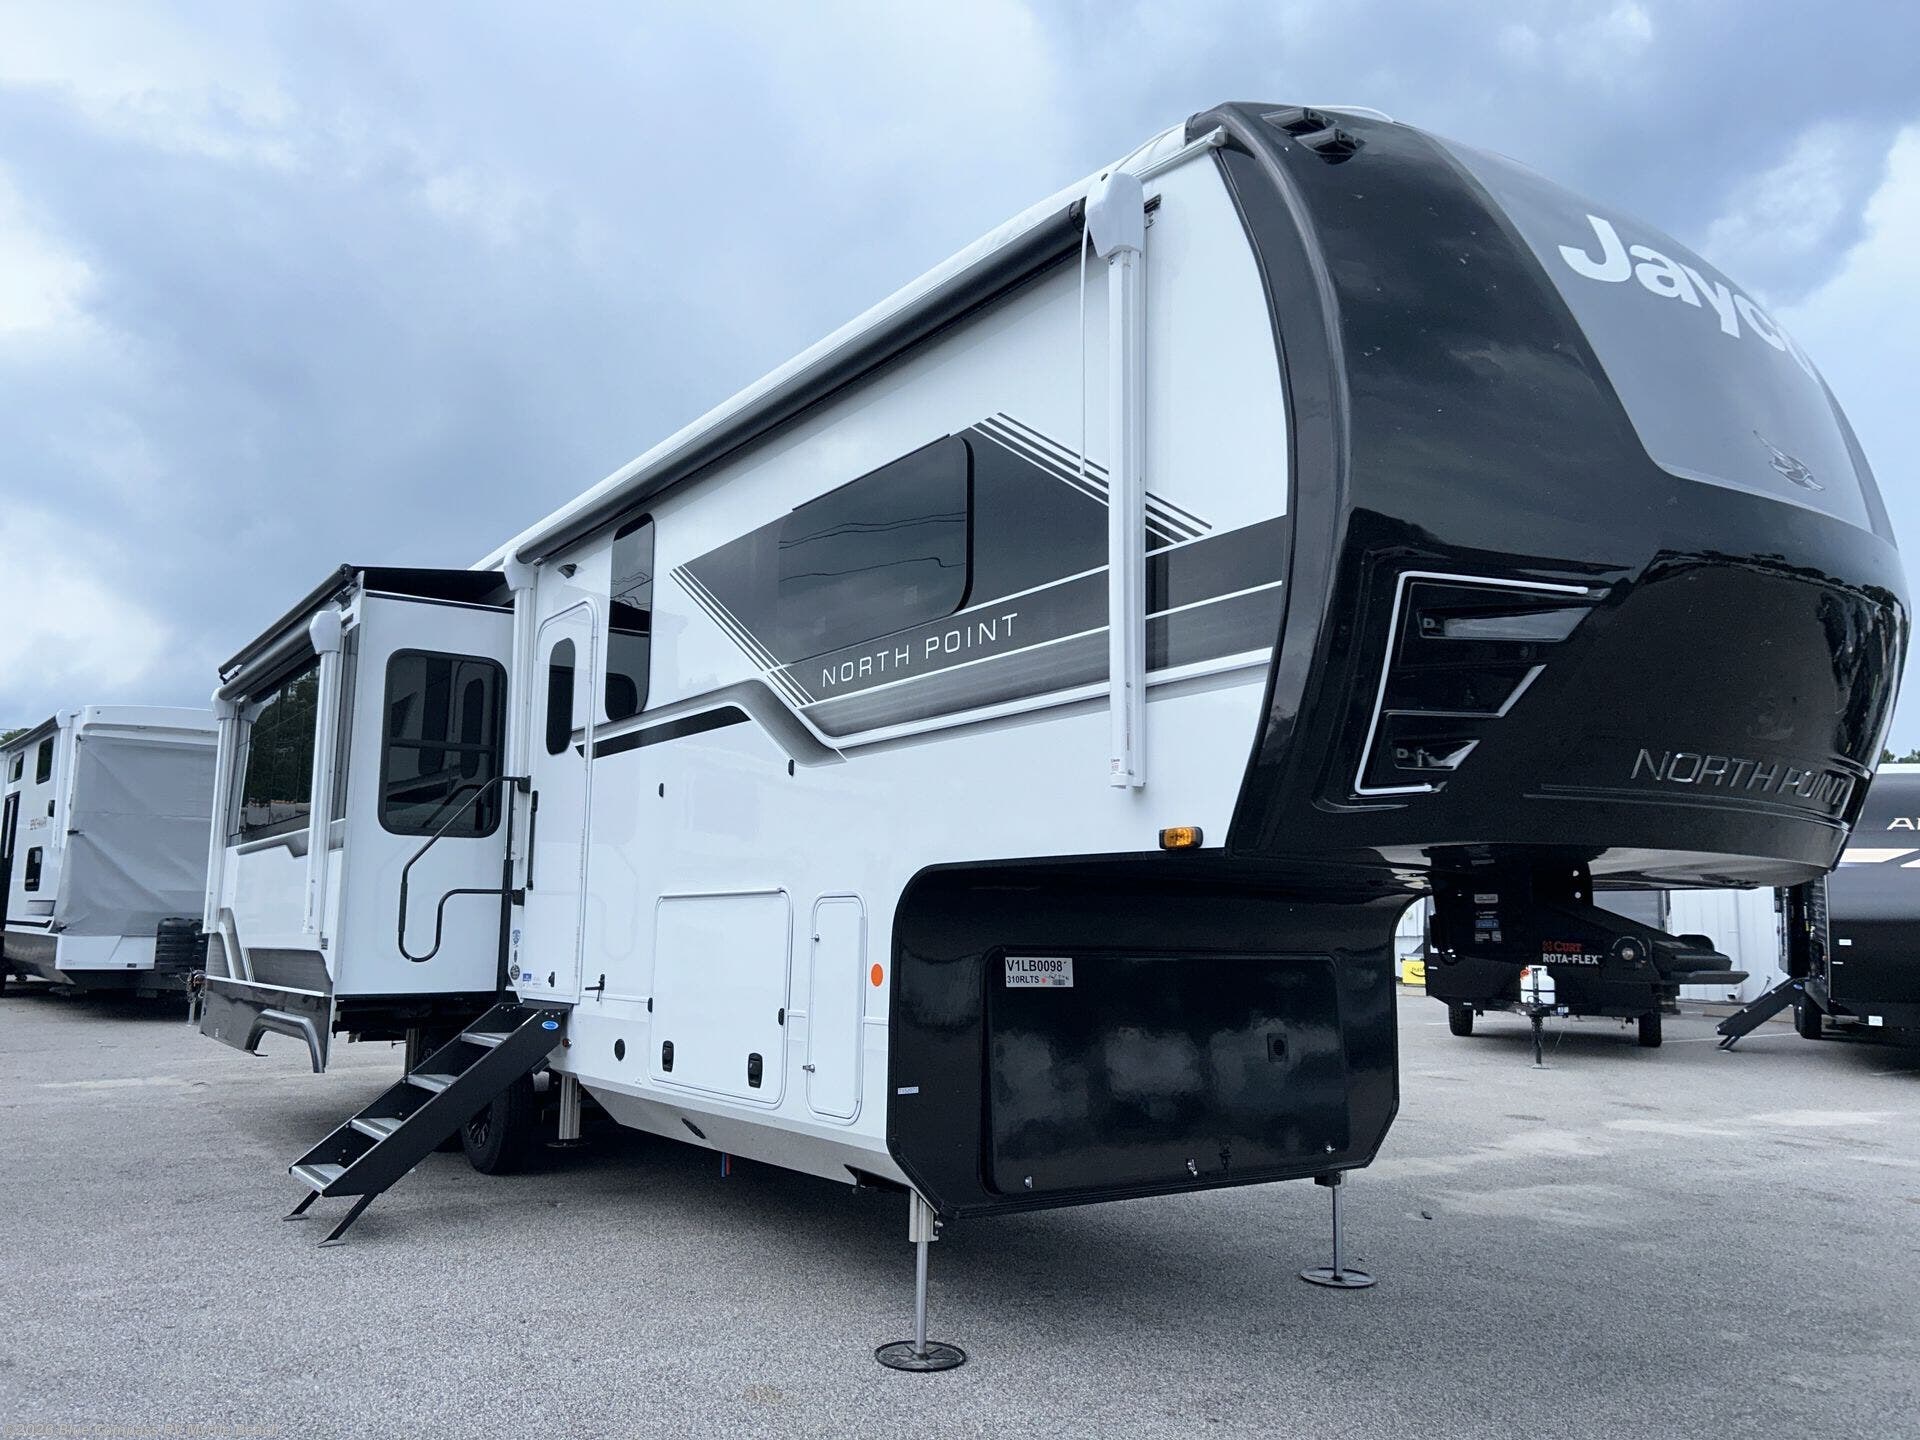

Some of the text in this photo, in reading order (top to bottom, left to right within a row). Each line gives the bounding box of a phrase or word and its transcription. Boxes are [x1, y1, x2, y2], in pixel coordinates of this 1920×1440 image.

[822, 612, 1018, 687] NORTH POINT
[1630, 748, 1849, 805] NORTH POINT
[1886, 817, 1920, 830] A
[1542, 953, 1599, 965] ROTA-FLEX
[1006, 960, 1063, 972] V1LB0098
[1007, 975, 1040, 984] 310RLTS
